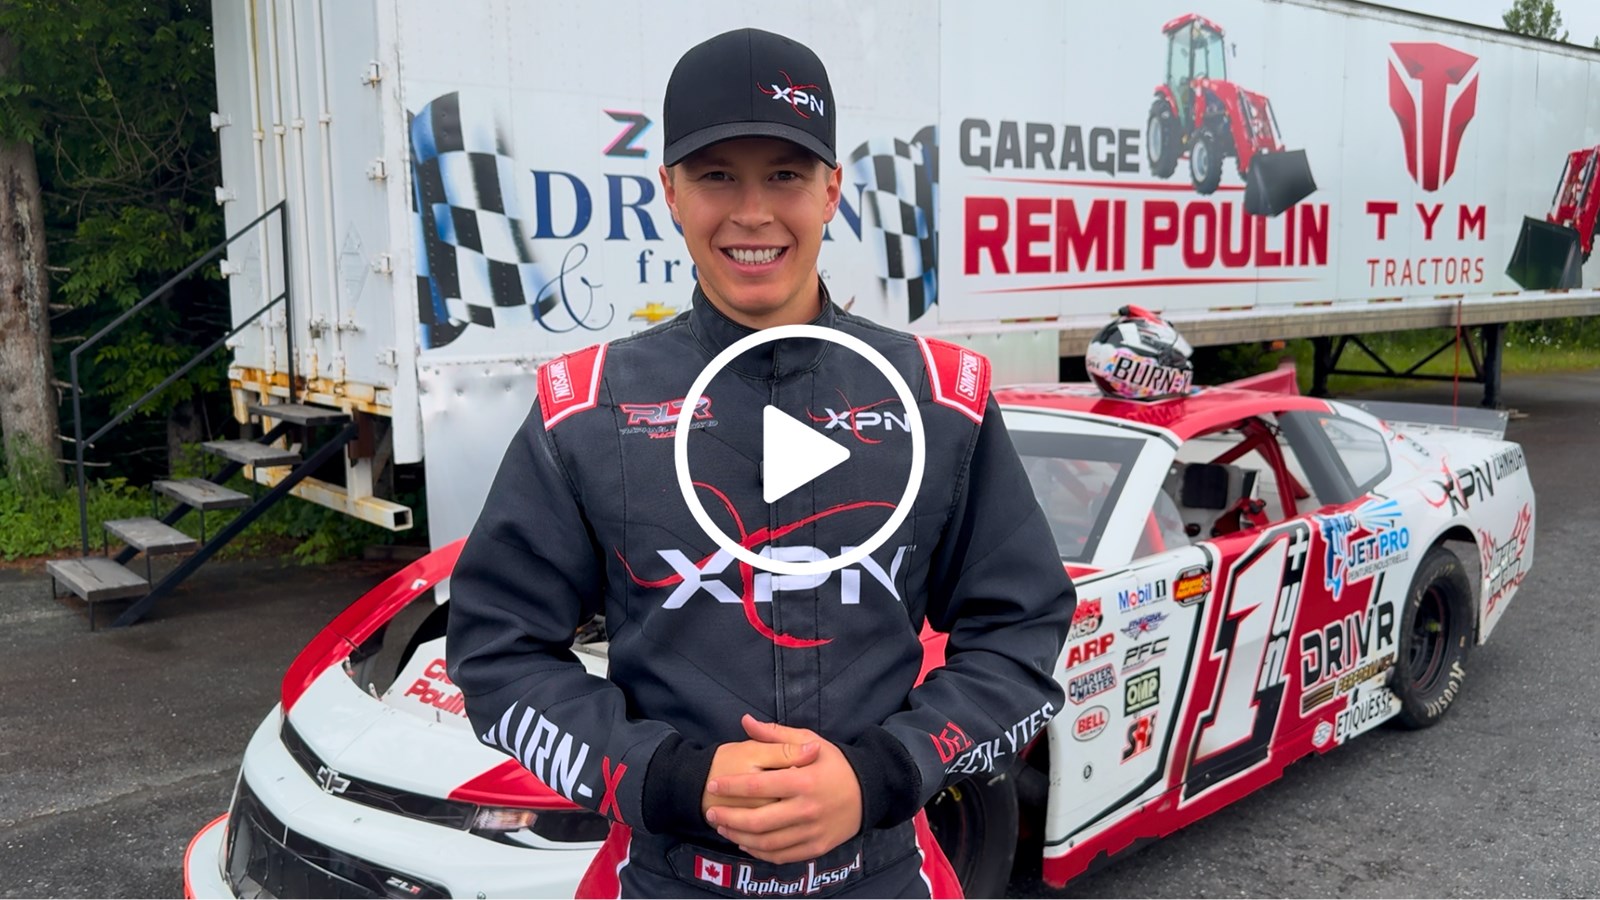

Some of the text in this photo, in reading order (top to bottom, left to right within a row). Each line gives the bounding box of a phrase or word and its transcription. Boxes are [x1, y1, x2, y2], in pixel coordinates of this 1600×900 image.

[771, 84, 824, 116] XPN
[959, 118, 1141, 176] GARAGE
[964, 195, 1329, 275] REMI POULIN
[1367, 258, 1485, 287] TRACTORS
[550, 361, 570, 397] SIMPSON
[959, 352, 977, 397] SIMPSON
[825, 408, 912, 433] XPN
[1431, 460, 1494, 517] XPN
[656, 545, 907, 609] XPN
[1118, 585, 1152, 610] Mobil
[1066, 632, 1115, 669] ARP
[1123, 636, 1170, 666] PFC
[1302, 601, 1394, 688] DRIVR
[1069, 667, 1113, 697] QUARTER
[1076, 678, 1113, 701] MASTER
[1127, 677, 1158, 706] OMP
[1077, 716, 1106, 734] BELL
[737, 852, 861, 894] Raphael Lessard
